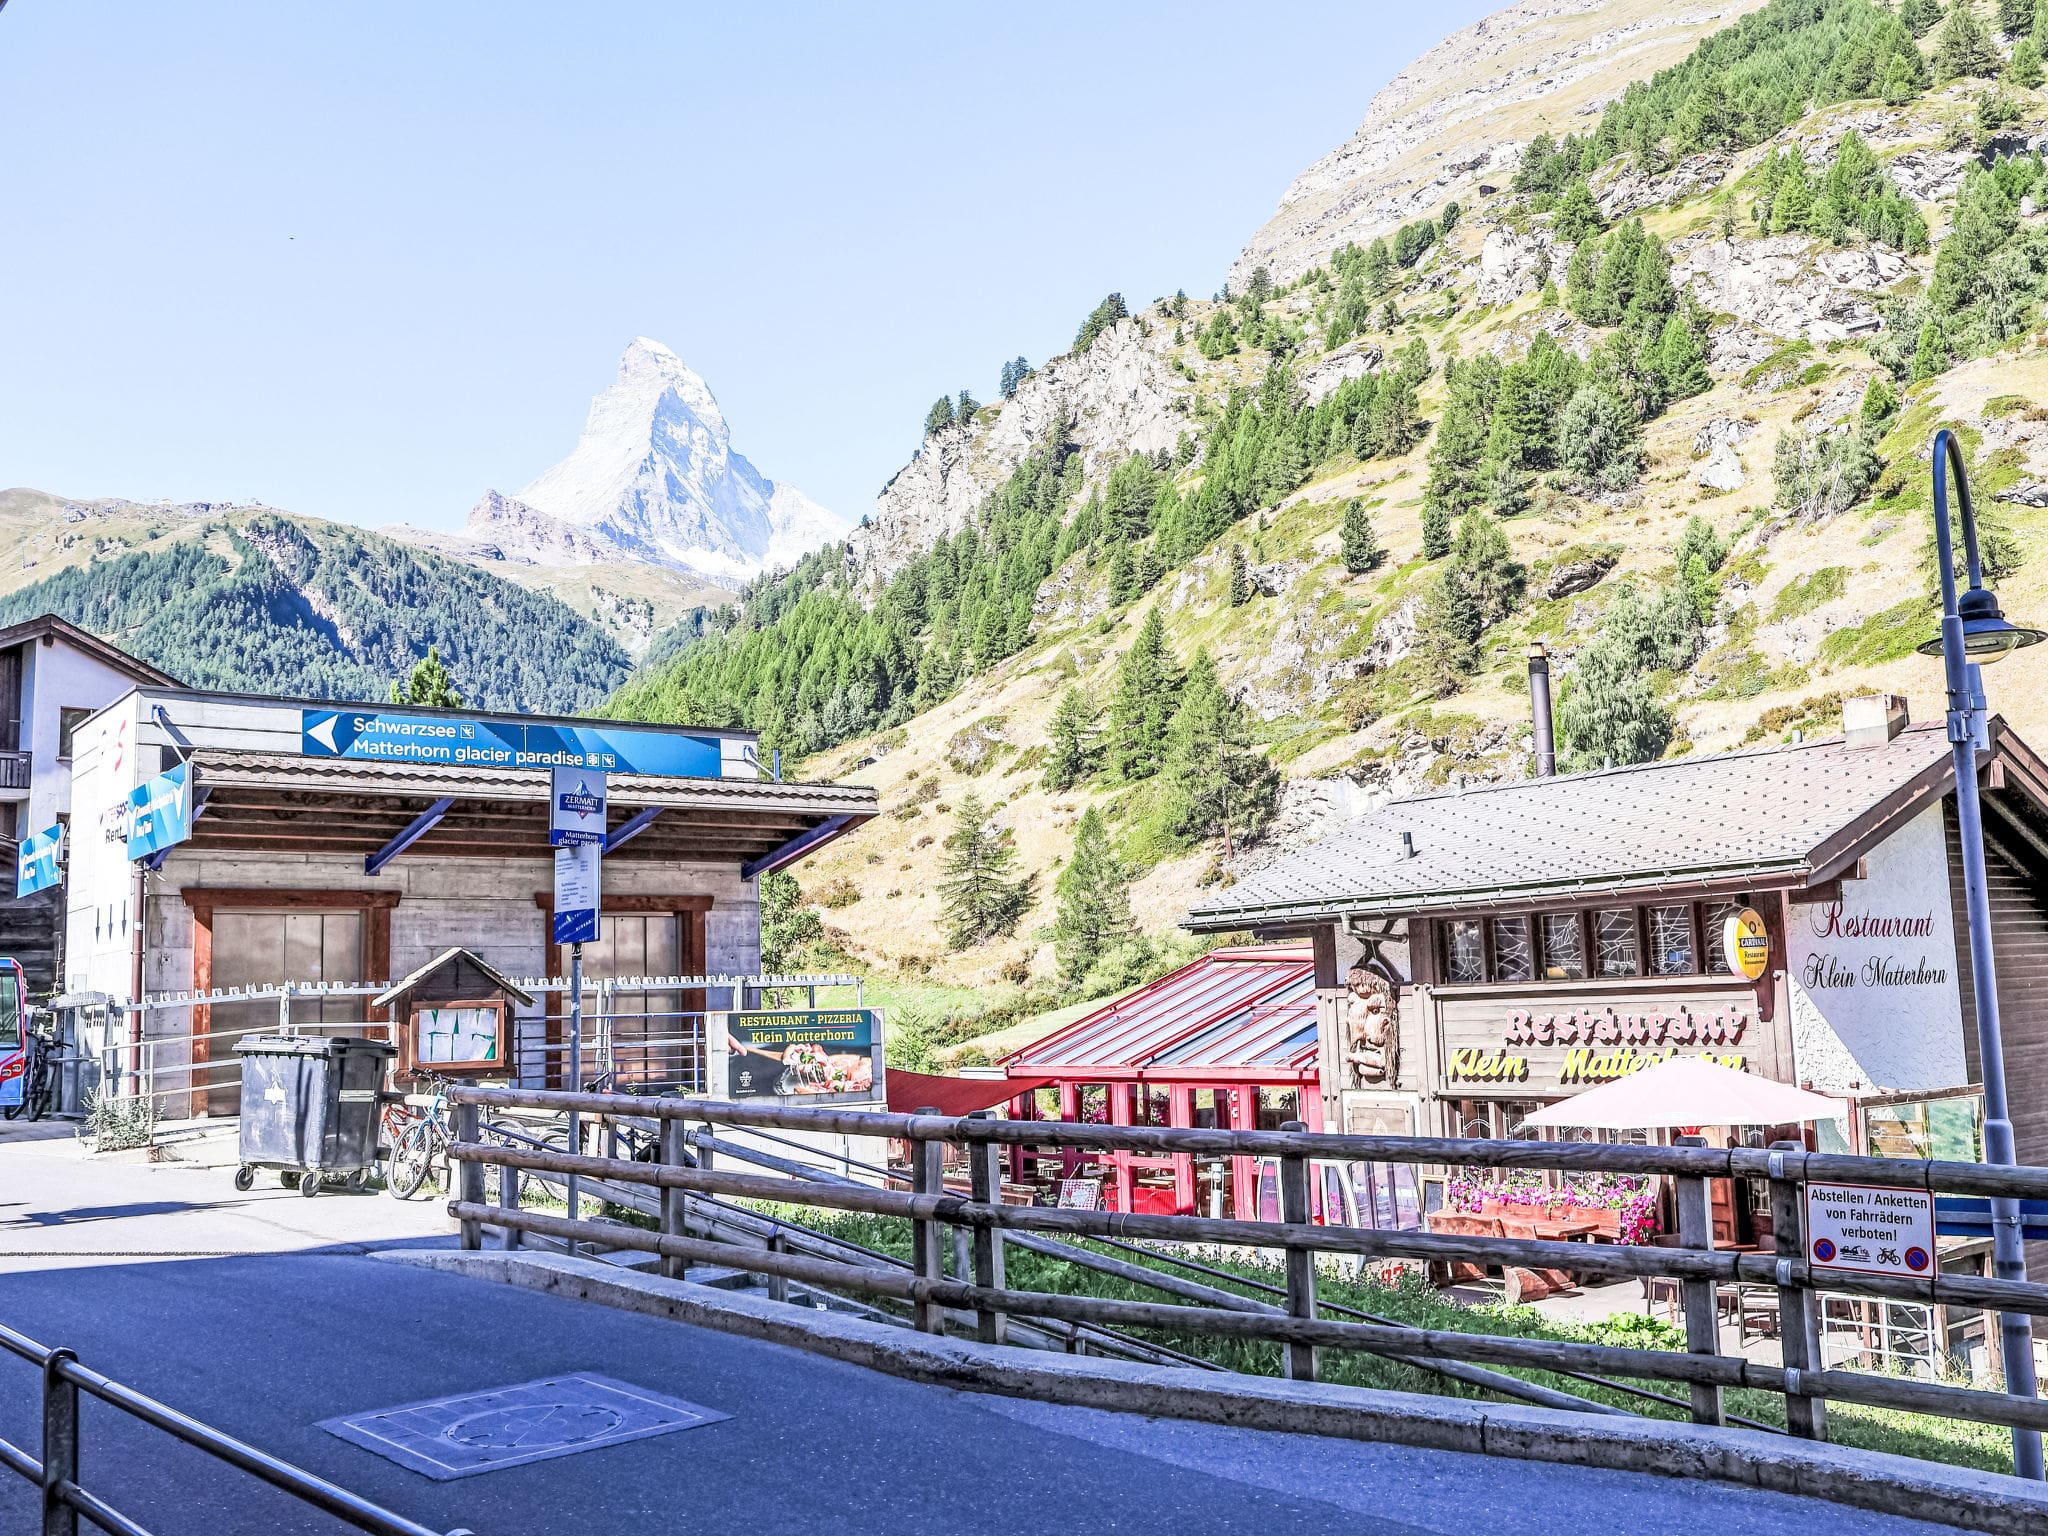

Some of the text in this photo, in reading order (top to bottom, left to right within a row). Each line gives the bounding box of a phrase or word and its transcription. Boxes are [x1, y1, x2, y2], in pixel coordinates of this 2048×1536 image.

[353, 717, 456, 738] Schwarzsee
[353, 739, 584, 766] Matterhorn glacier paradise
[565, 796, 598, 806] ZERMATT
[558, 837, 579, 845] glacier
[565, 831, 599, 840] Matterhorn
[1810, 900, 1934, 938] Restaurant
[1741, 938, 1766, 946] CARDINAL
[1803, 953, 1948, 989] Klein Matterhorn
[739, 1015, 809, 1027] RESTAURANT
[818, 1014, 863, 1024] PIZZERIA
[1502, 1004, 1745, 1042] Restaurant
[751, 1029, 855, 1044] Klein Matterhorn
[1448, 1048, 1525, 1077] Klein
[1811, 1189, 1864, 1204] Abstellen
[1874, 1193, 1928, 1209] Anketten
[1826, 1208, 1913, 1226] von Fahrrädern
[1841, 1226, 1898, 1242] verboten!
